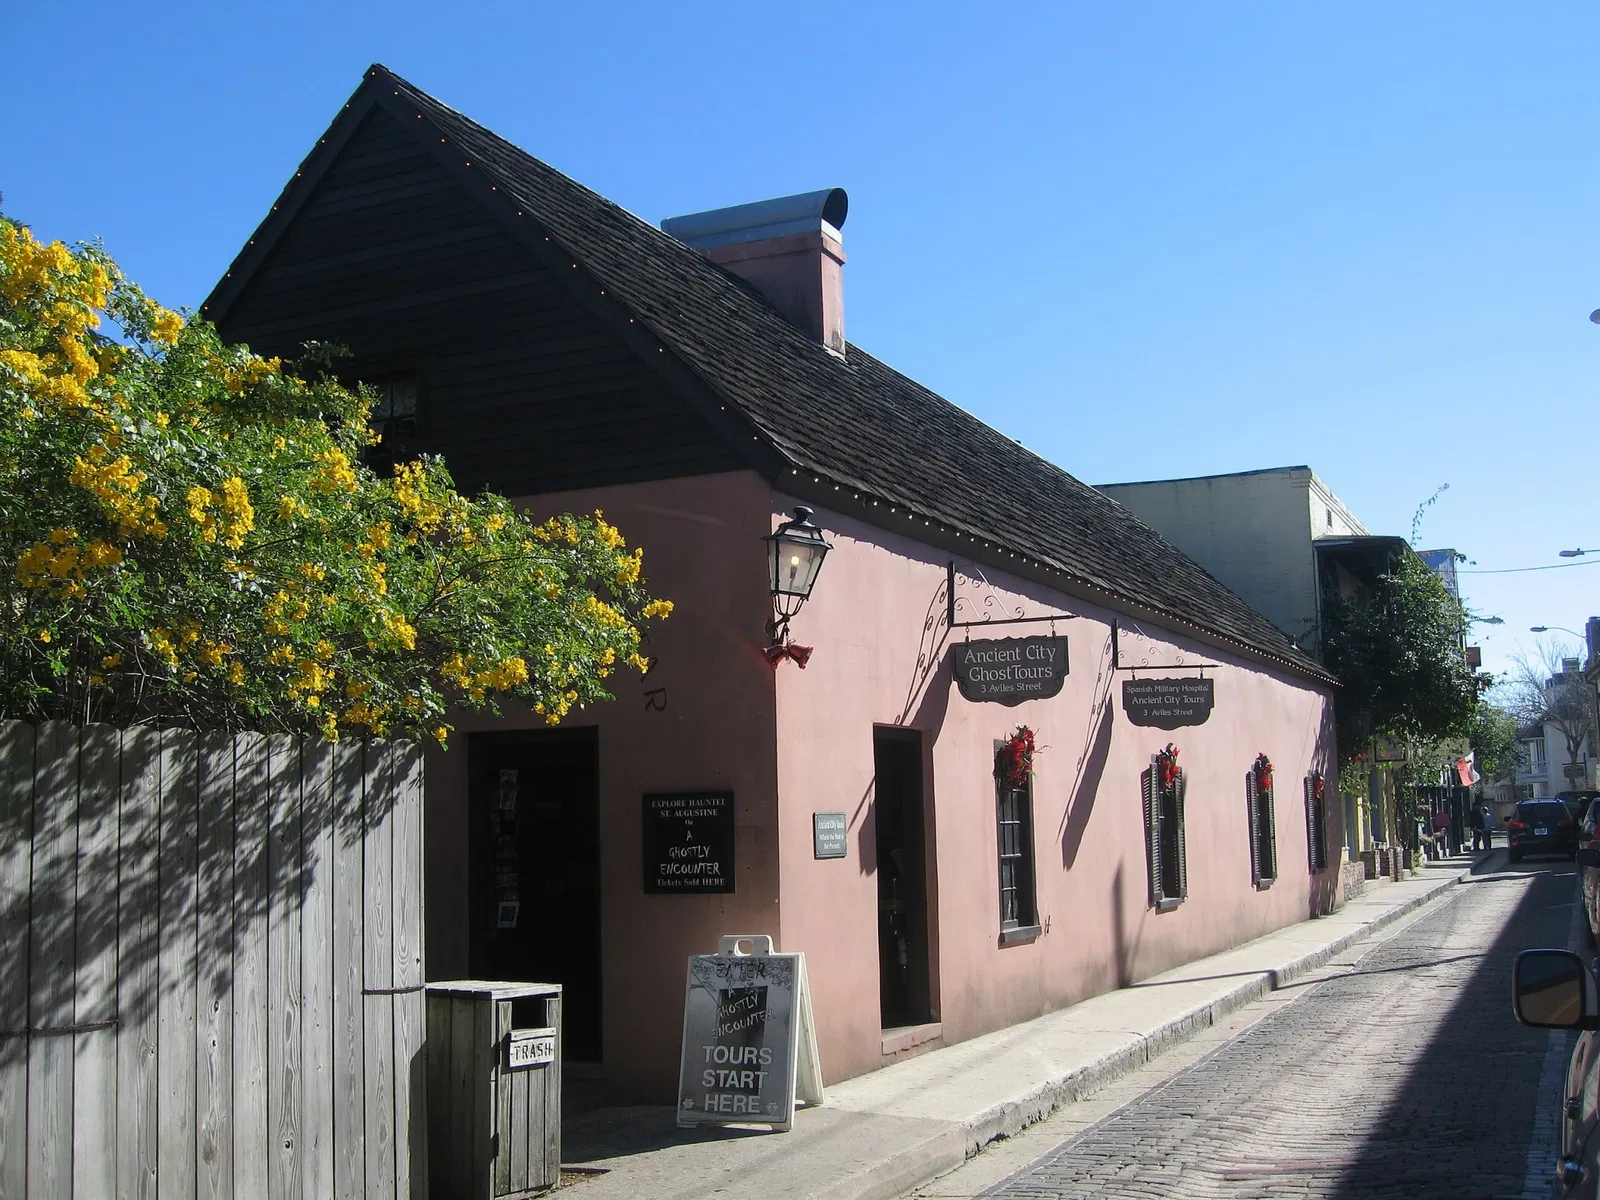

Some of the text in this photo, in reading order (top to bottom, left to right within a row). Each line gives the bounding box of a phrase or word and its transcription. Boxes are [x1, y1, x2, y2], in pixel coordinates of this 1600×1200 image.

[965, 645, 1056, 663] Ancient City
[969, 665, 1053, 681] Ghost Tours
[981, 682, 1042, 693] 3 Aviles Street
[1127, 684, 1209, 694] Spanish Military Hospital
[1132, 695, 1205, 705] Ancient City Tours
[652, 800, 686, 808] EXPLORE
[674, 808, 718, 817] AUGUSTINE
[686, 830, 692, 841] A
[669, 845, 711, 858] GHOSTLY
[660, 862, 720, 875] ENCOUNTER
[702, 878, 725, 886] HERE
[728, 987, 736, 998] A
[710, 1007, 777, 1039] ENCOUNTER
[514, 1043, 551, 1060] TRASH
[702, 1045, 773, 1064] TOURS
[702, 1070, 768, 1089] START
[705, 1094, 761, 1113] HERE
